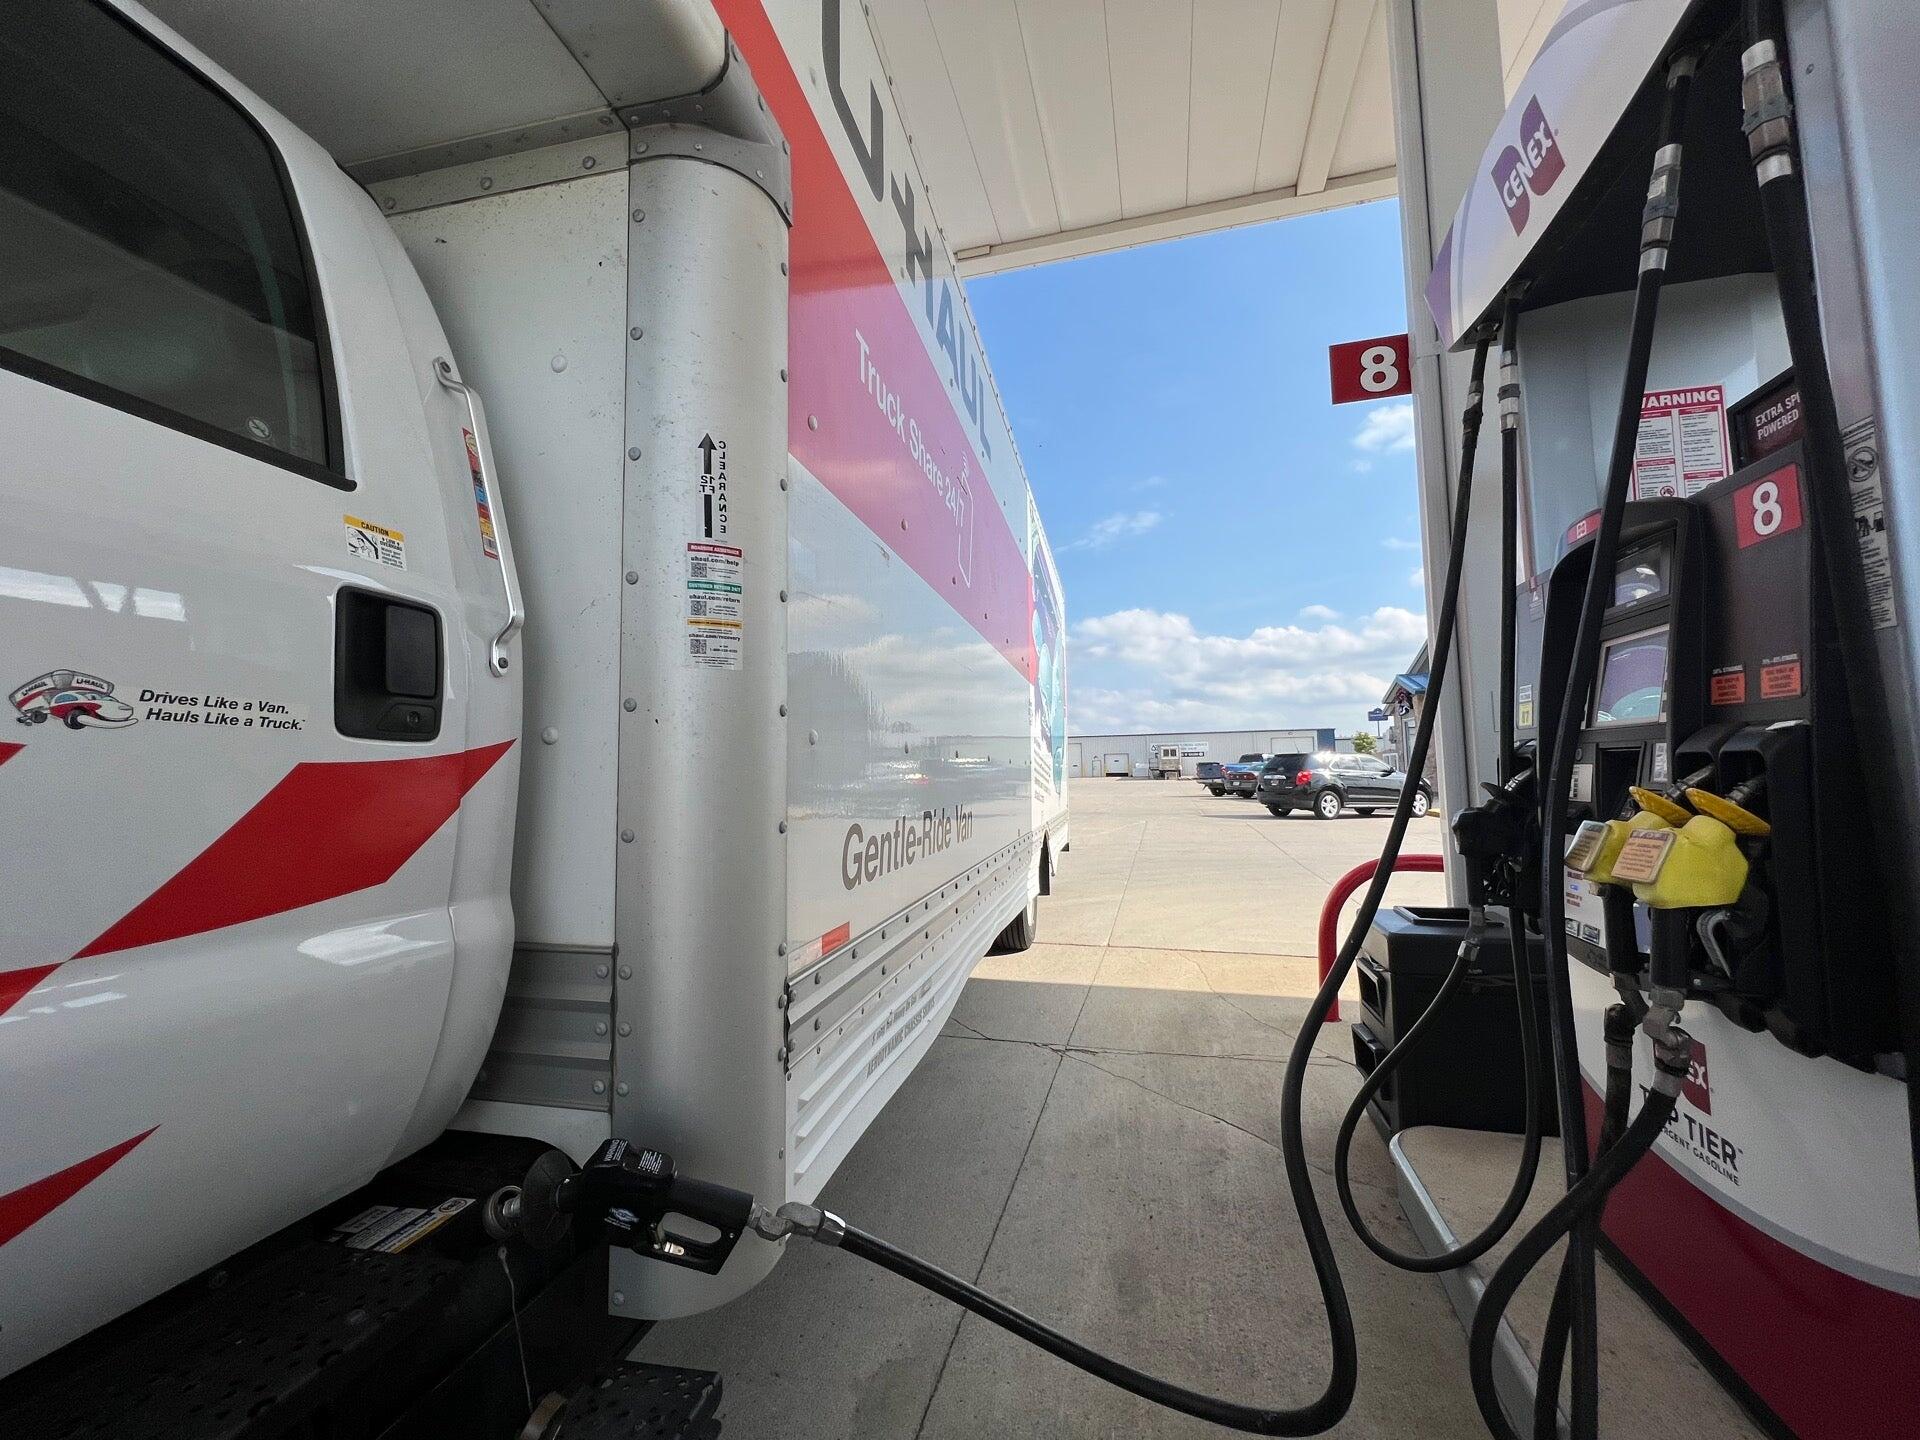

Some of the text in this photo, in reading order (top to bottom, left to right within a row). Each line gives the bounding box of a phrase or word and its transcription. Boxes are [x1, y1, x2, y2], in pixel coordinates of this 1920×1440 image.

[1502, 121, 1552, 208] CENEX
[1360, 345, 1399, 392] 8
[855, 329, 966, 528] Truck Share 24/7
[1755, 402, 1784, 427] EXTRA
[1757, 409, 1799, 440] POWERED
[361, 522, 389, 536] CAUTION
[1752, 481, 1782, 536] 8
[139, 689, 289, 715] Drives Like a Van.
[146, 707, 303, 731] Hauls Like a Truck.
[841, 804, 974, 891] Gentle-Ride Van
[1639, 1083, 1739, 1173] TP TIER
[1662, 1126, 1741, 1187] RGENT GASOLINE
